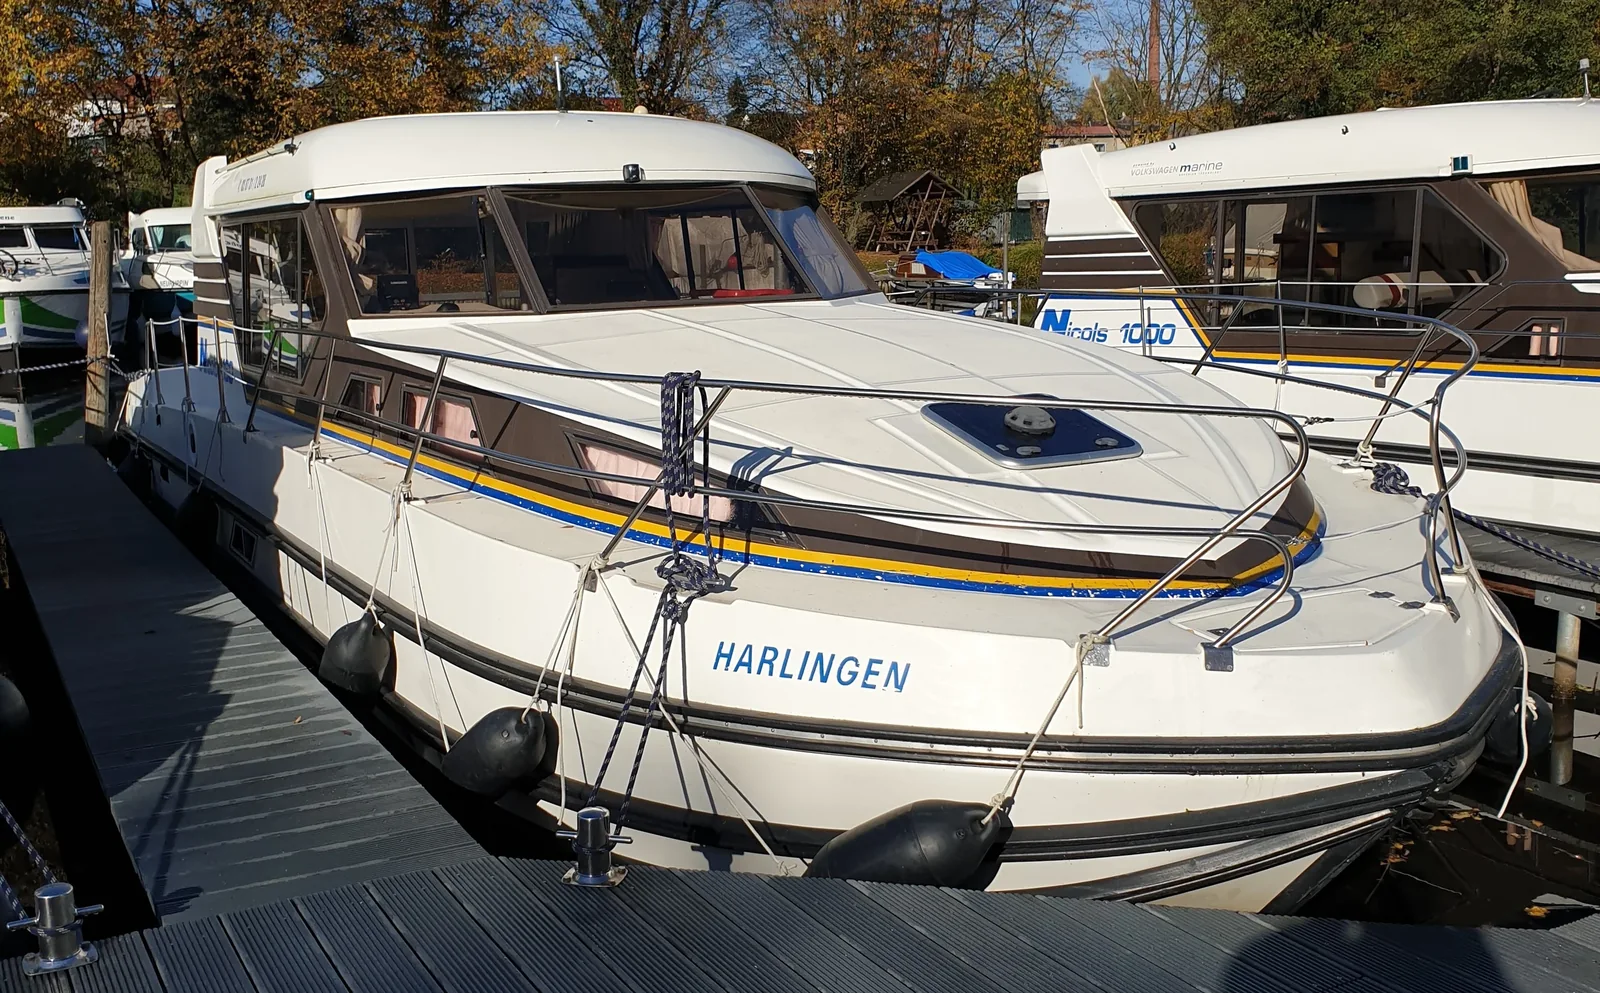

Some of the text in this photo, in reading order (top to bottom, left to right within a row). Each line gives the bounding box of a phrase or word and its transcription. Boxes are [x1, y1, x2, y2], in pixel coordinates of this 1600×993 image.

[1130, 166, 1179, 176] VOLKSWAGEN
[1179, 161, 1223, 172] marine
[1040, 308, 1176, 345] Nicols 1000
[712, 641, 911, 693] HARLINGEN
